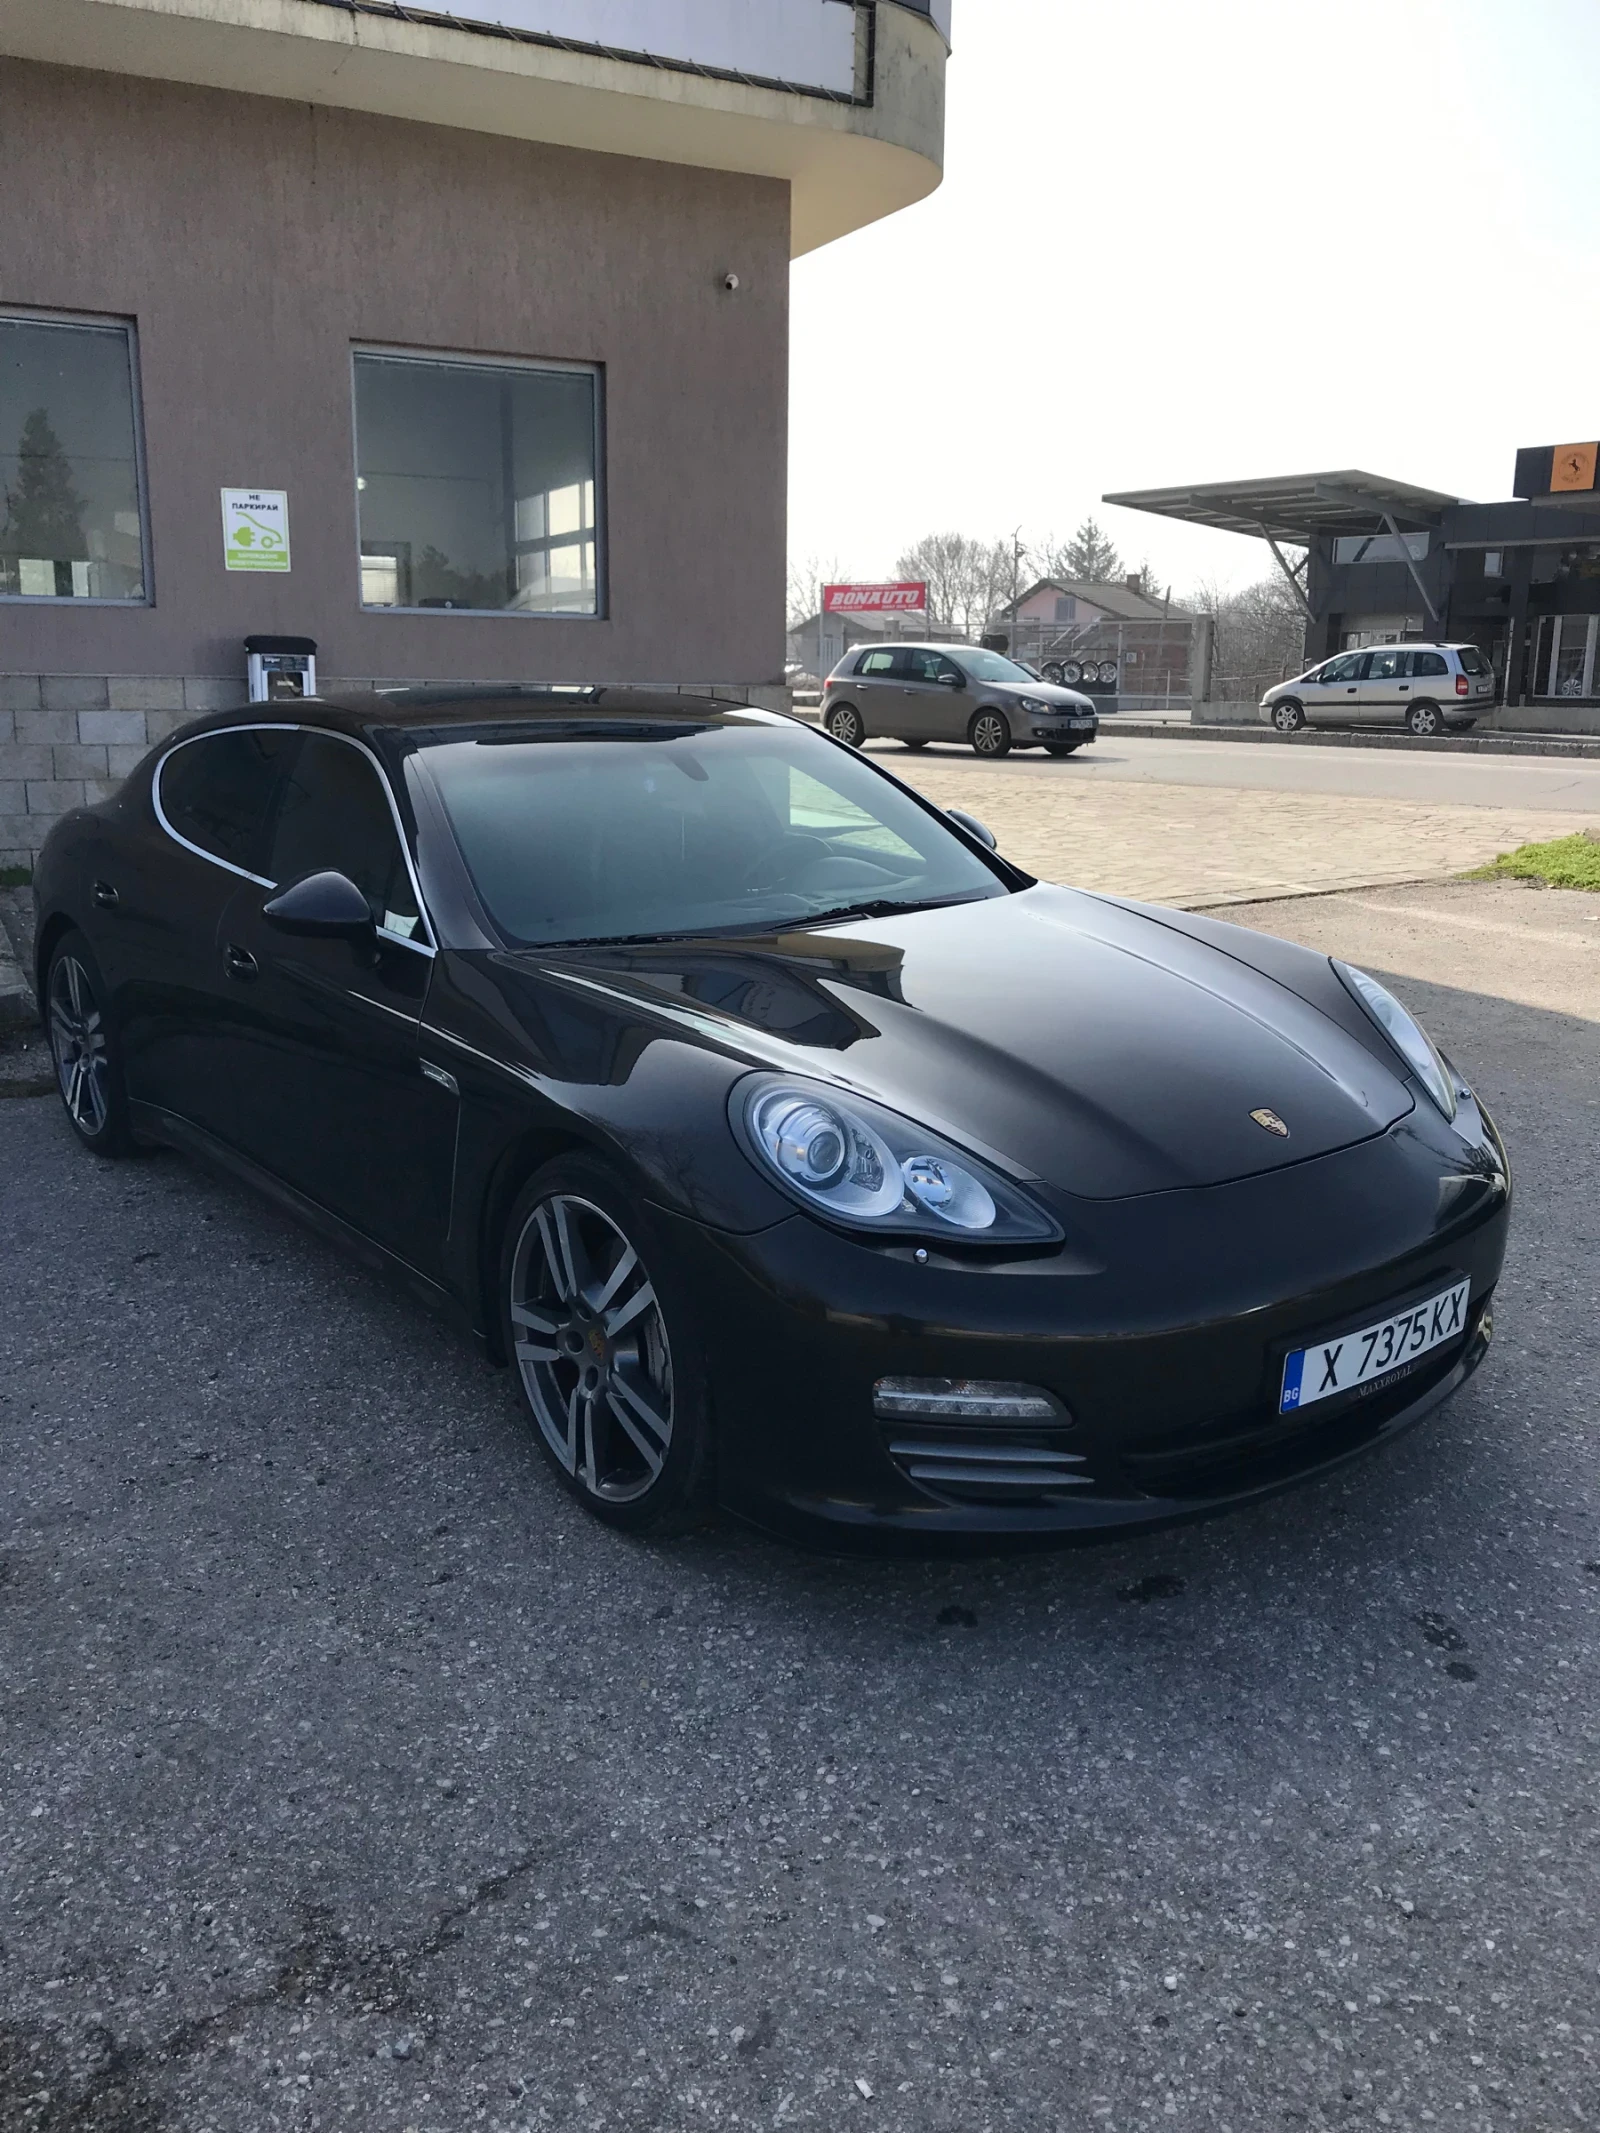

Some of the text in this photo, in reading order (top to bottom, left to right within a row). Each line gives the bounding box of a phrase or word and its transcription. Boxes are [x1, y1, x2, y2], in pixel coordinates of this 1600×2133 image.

[232, 502, 279, 511] ПАРКИРАЙ
[829, 589, 920, 606] BONAUTO
[1319, 1344, 1343, 1392] X
[1283, 1387, 1299, 1403] BG
